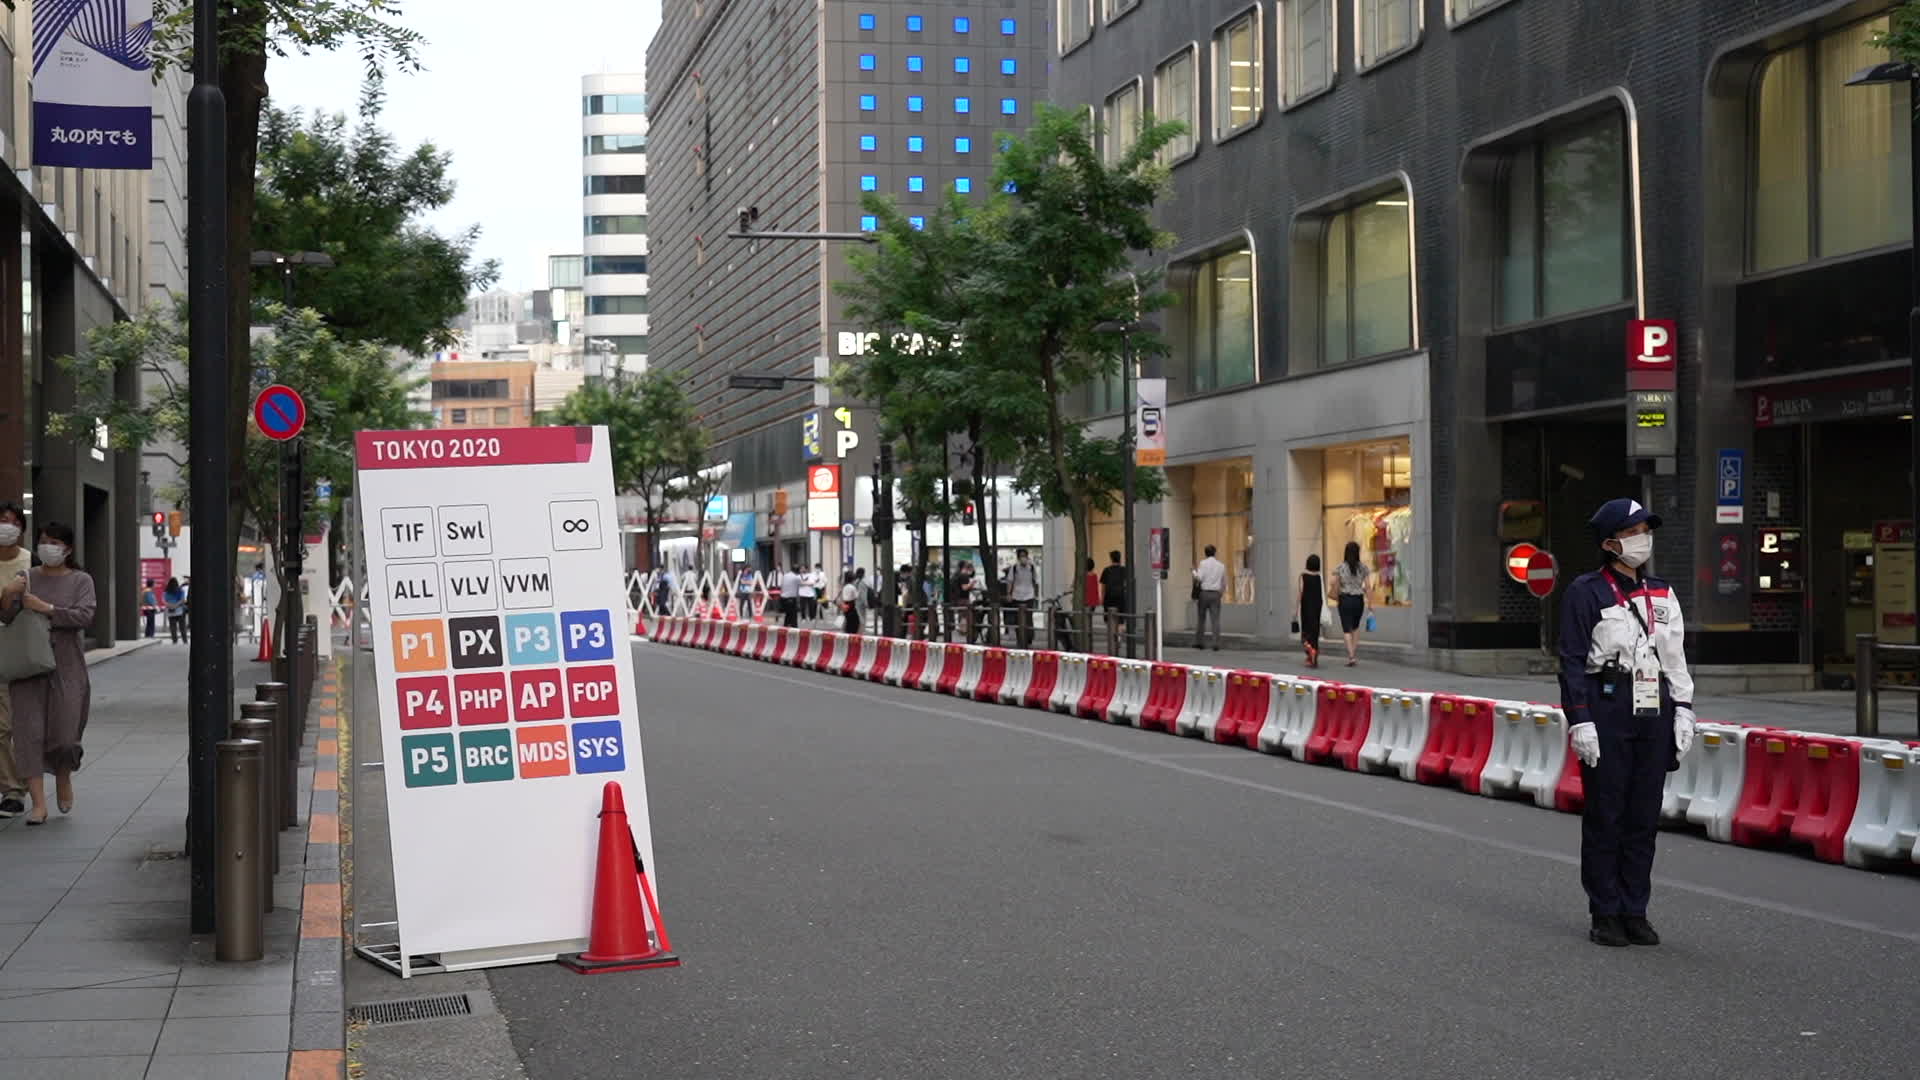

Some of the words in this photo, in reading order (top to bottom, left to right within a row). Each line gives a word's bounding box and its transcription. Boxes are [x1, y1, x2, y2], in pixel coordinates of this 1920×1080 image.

[51, 126, 136, 146] 丸の内でも
[1643, 326, 1668, 356] P
[373, 439, 445, 461] TOKYO
[449, 438, 501, 458] 2020
[837, 430, 859, 458] P
[1724, 480, 1737, 496] P
[391, 522, 424, 543] TIF
[394, 579, 433, 600] ALL
[451, 576, 490, 597] VLV
[503, 572, 549, 594] VVM
[401, 632, 435, 659] P1
[459, 629, 495, 656] PX
[514, 625, 551, 652] P3
[569, 622, 605, 649] P3
[406, 689, 444, 717] P4
[460, 687, 503, 710] PHP
[520, 682, 556, 710] AP
[572, 680, 613, 702] FOP
[411, 746, 448, 775] P5
[465, 743, 509, 768] BRC
[520, 739, 568, 763] MDS
[578, 736, 619, 759] SYS
